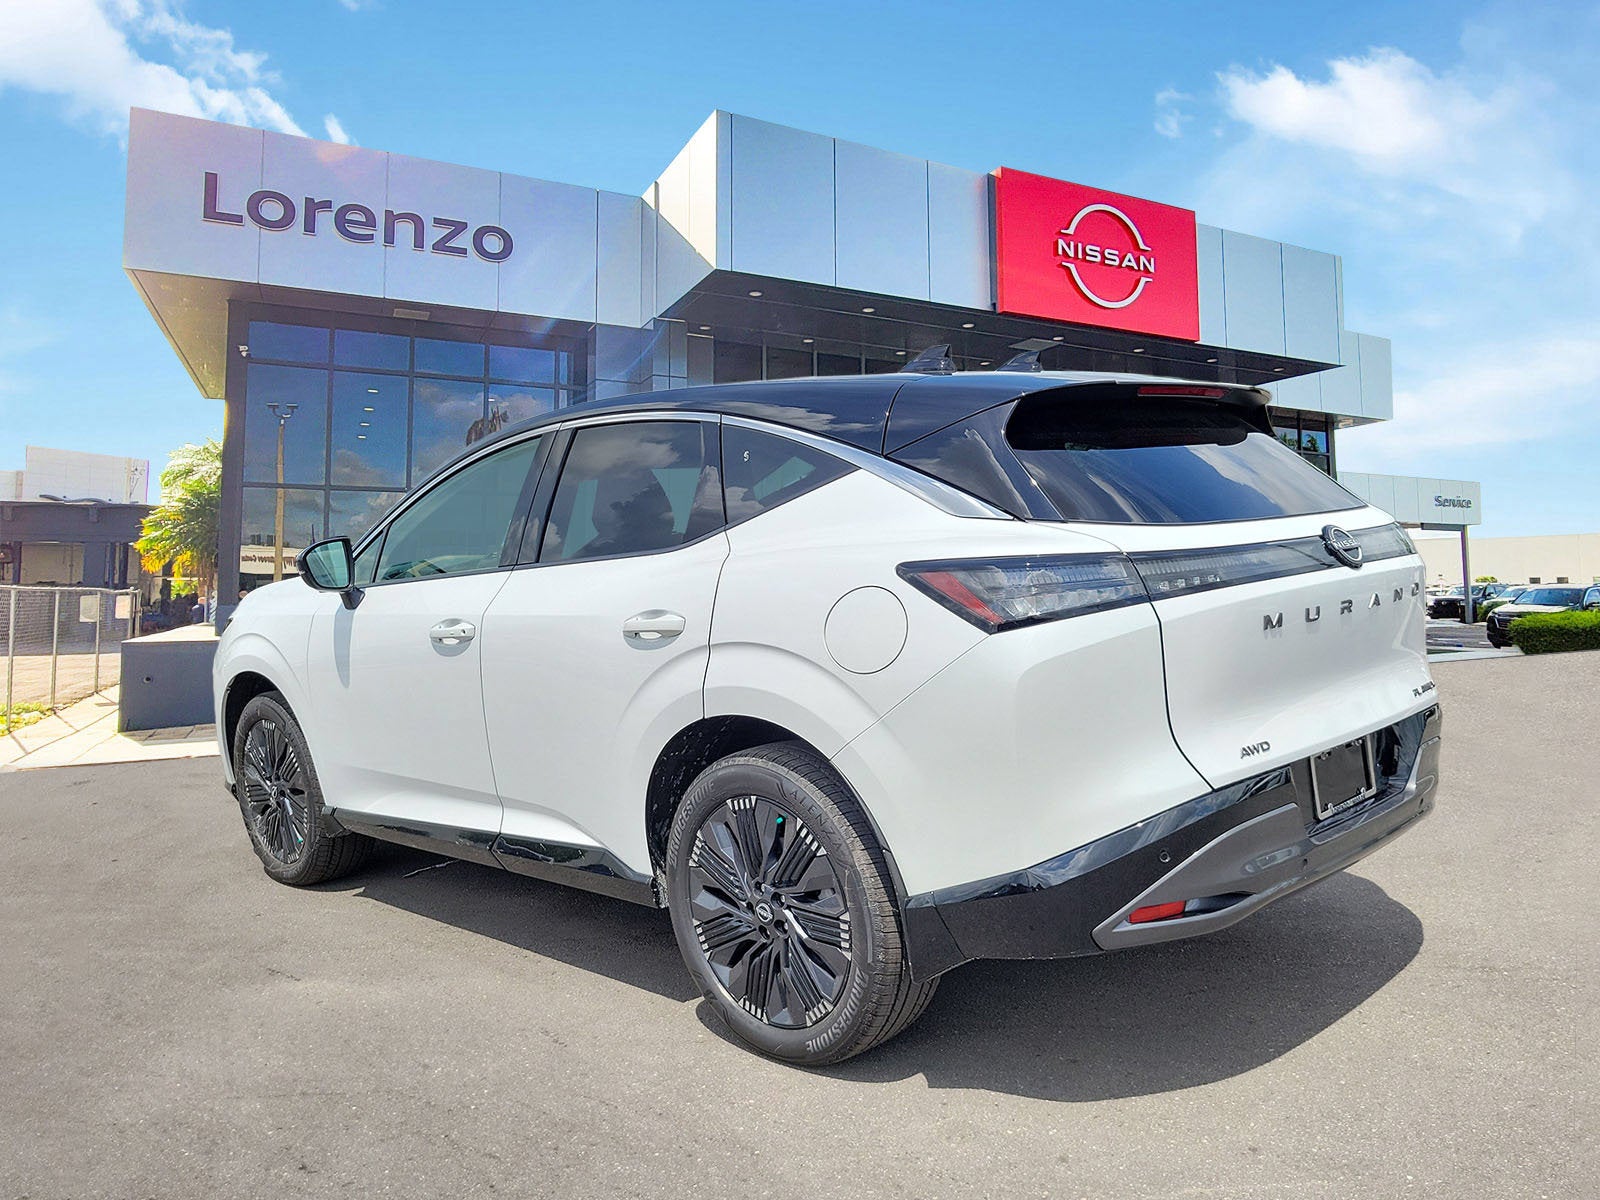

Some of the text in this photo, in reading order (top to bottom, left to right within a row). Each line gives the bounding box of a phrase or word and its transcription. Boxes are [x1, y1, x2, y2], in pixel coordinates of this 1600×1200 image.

[203, 171, 514, 262] Lorenzo
[1057, 238, 1155, 273] NISSAN
[1434, 495, 1472, 509] Service
[1263, 582, 1420, 631] MURANO
[1240, 740, 1271, 760] AWD
[667, 780, 715, 869] BRIDGESTONE
[789, 789, 842, 850] ALENZA
[805, 966, 869, 1053] BRIDGESTONE
